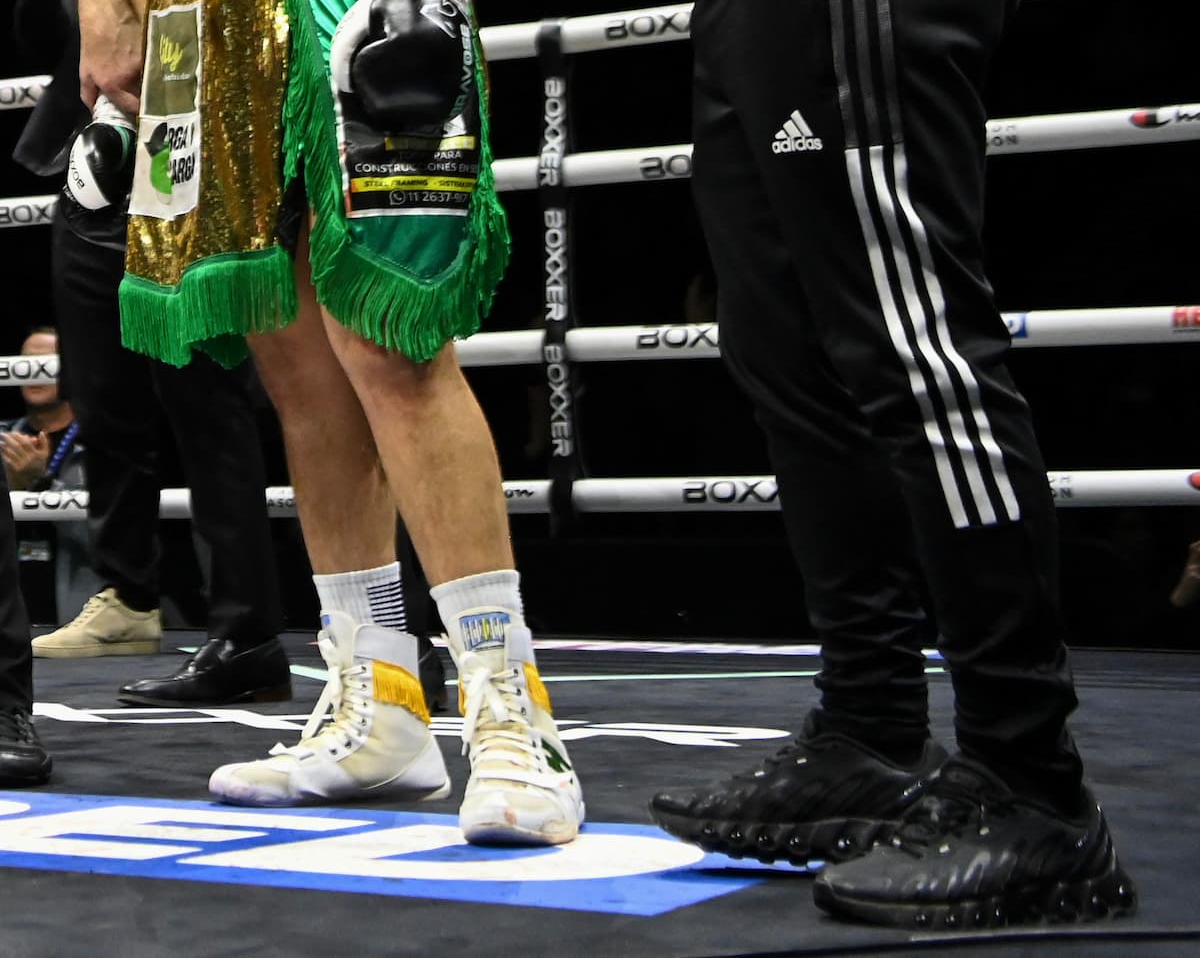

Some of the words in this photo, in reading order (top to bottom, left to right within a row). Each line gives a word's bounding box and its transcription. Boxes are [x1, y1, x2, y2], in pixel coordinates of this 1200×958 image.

[606, 12, 692, 41] BOX
[539, 77, 566, 186] BOXXER
[772, 136, 823, 154] adidas
[355, 161, 457, 174] CONSTRUONES
[544, 208, 568, 321] BOXXER
[636, 324, 719, 350] BOX
[543, 344, 574, 457] BOXXER
[22, 492, 88, 510] BOX
[682, 480, 778, 504] BOX
